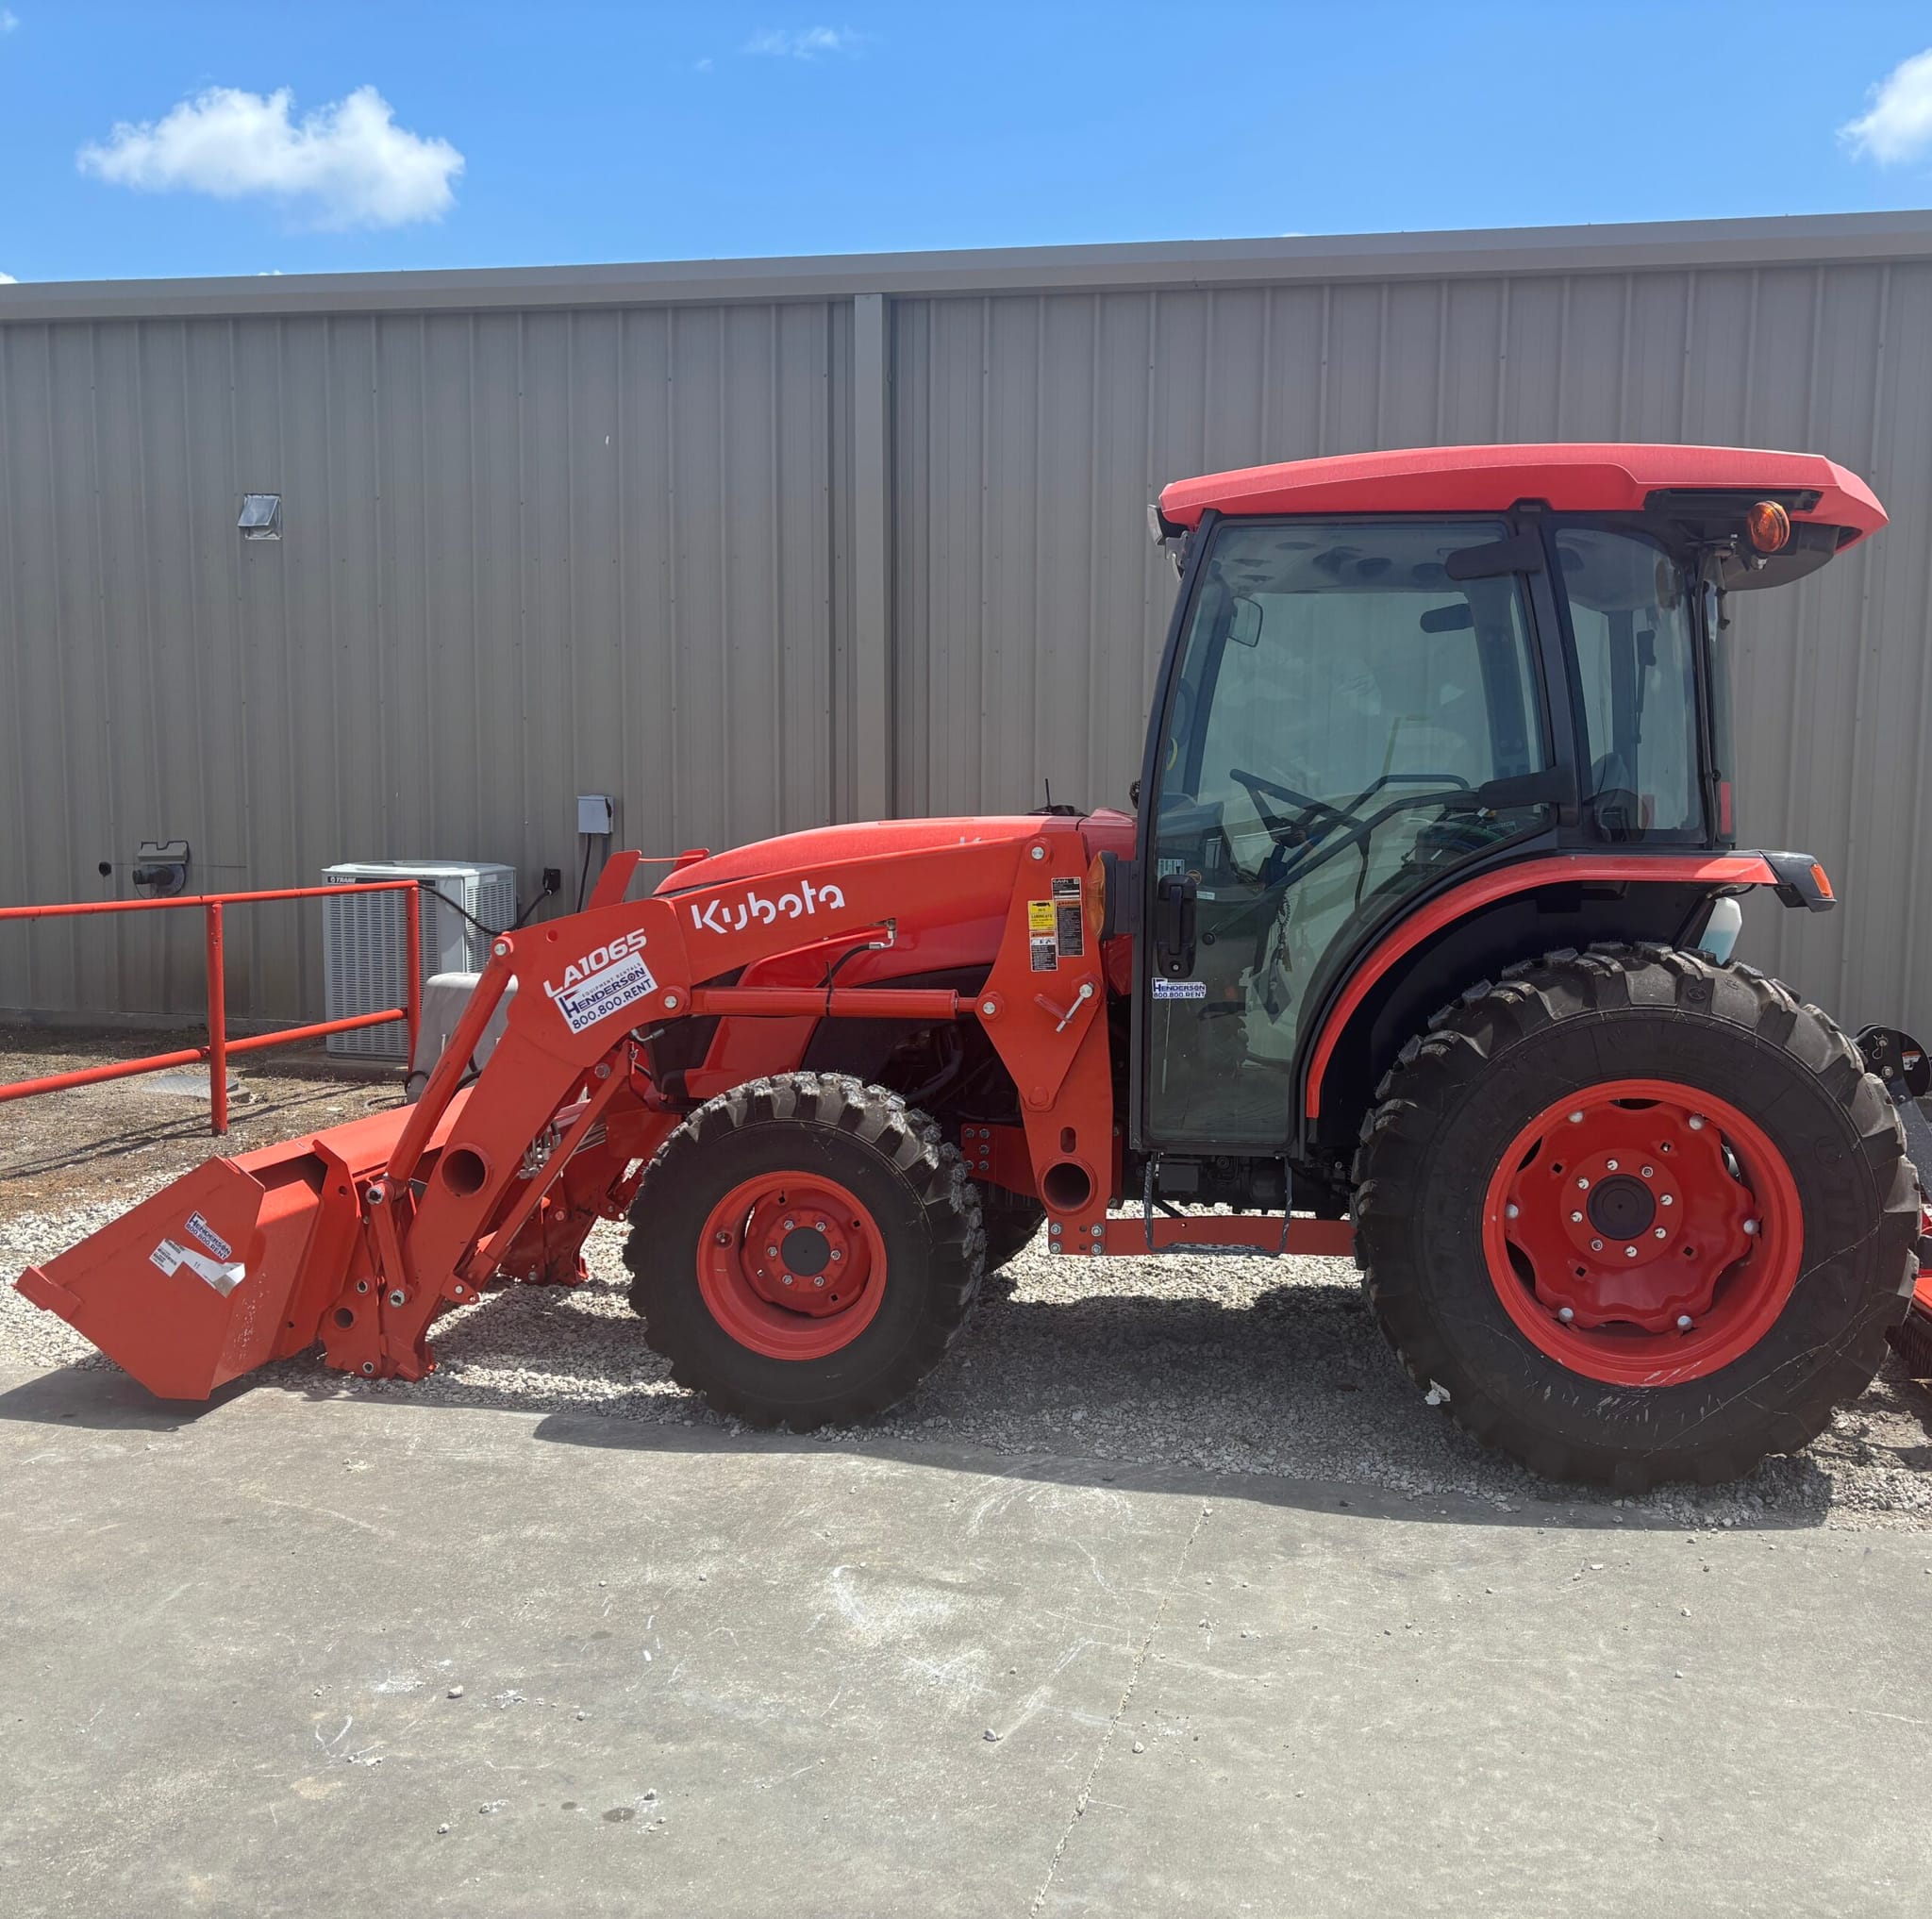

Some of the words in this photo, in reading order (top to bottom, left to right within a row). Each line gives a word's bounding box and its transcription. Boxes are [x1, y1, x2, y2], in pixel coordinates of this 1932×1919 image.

[691, 879, 846, 934] Kubota
[542, 927, 647, 998] LA1065
[581, 976, 615, 998] EQUIPMENT
[615, 962, 641, 979] RENTALS
[1153, 979, 1206, 993] HENDERSON
[558, 966, 647, 1019] HENDERSON
[572, 977, 653, 1030] 800.800.RENT
[185, 1223, 227, 1260] 800.800.RENT
[189, 1212, 231, 1256] HENDERSON
